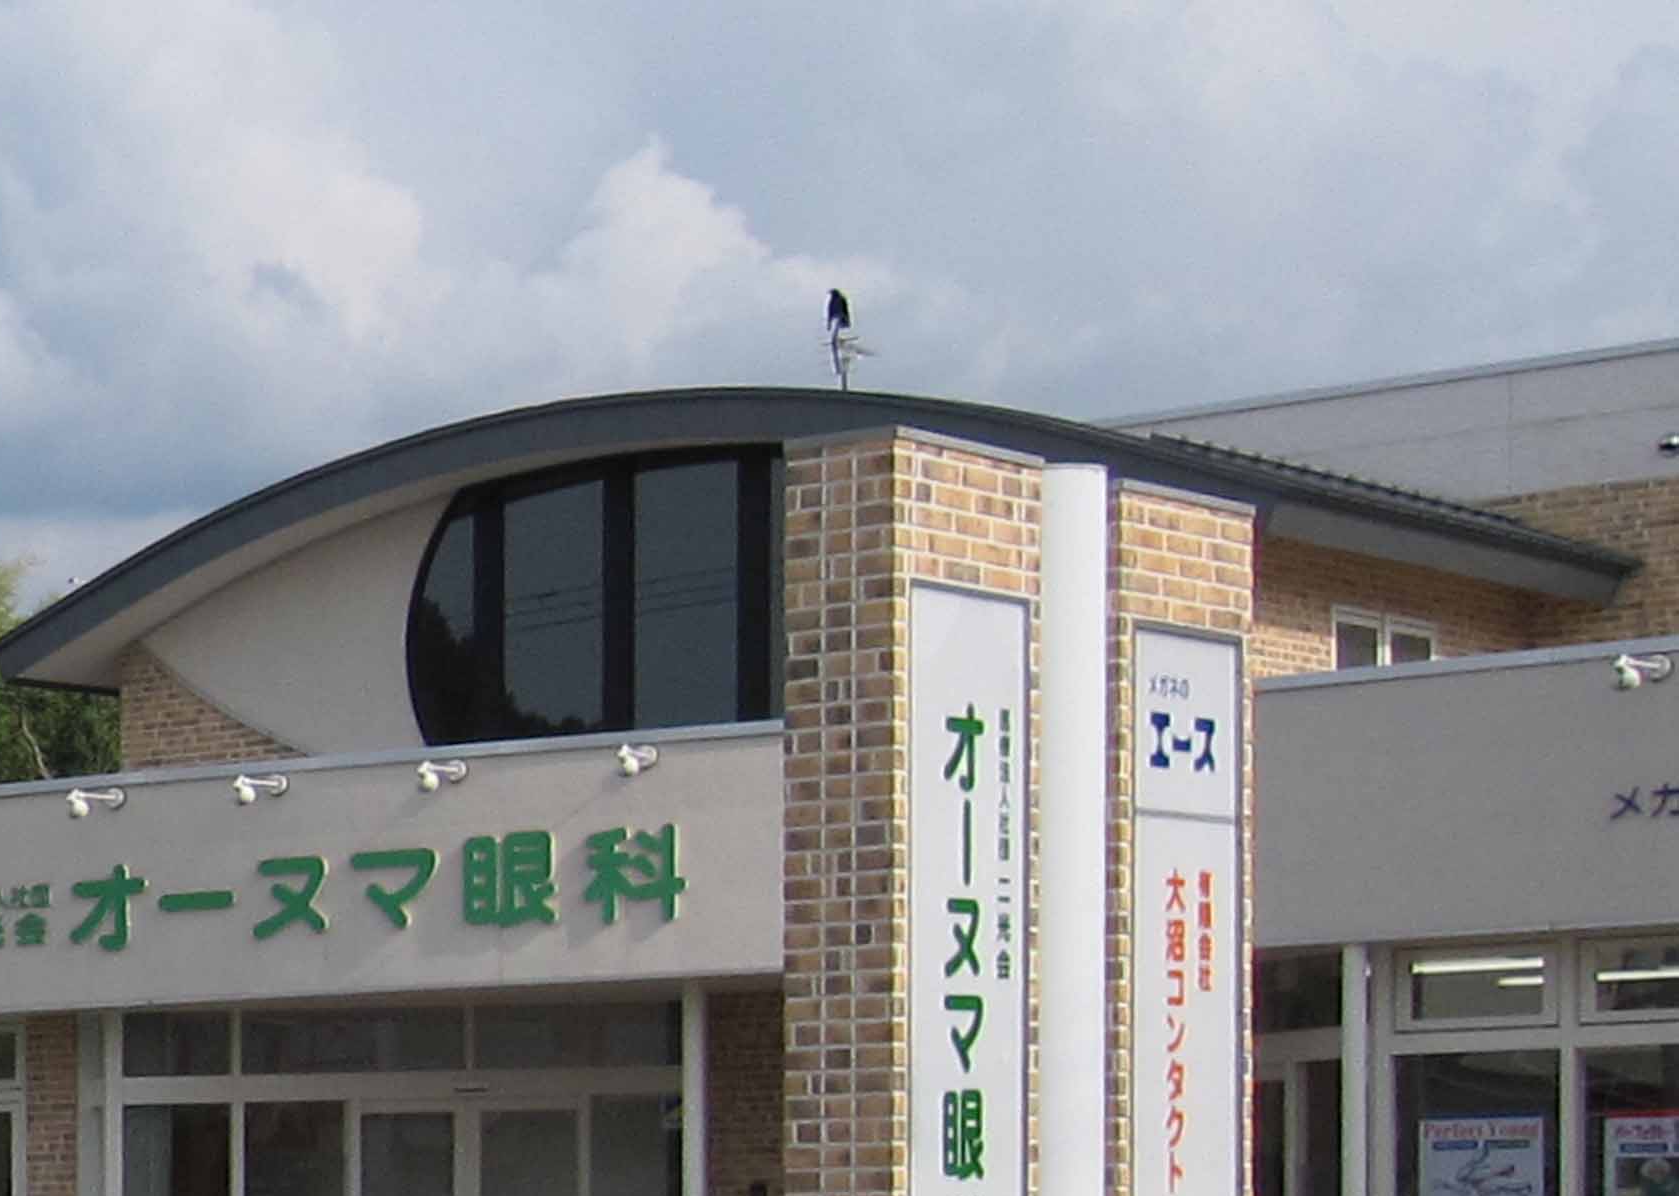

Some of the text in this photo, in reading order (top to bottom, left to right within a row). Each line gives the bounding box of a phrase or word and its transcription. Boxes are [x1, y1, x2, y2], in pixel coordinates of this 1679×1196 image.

[1149, 711, 1215, 773] エース
[68, 822, 688, 953] オーヌマ眼科
